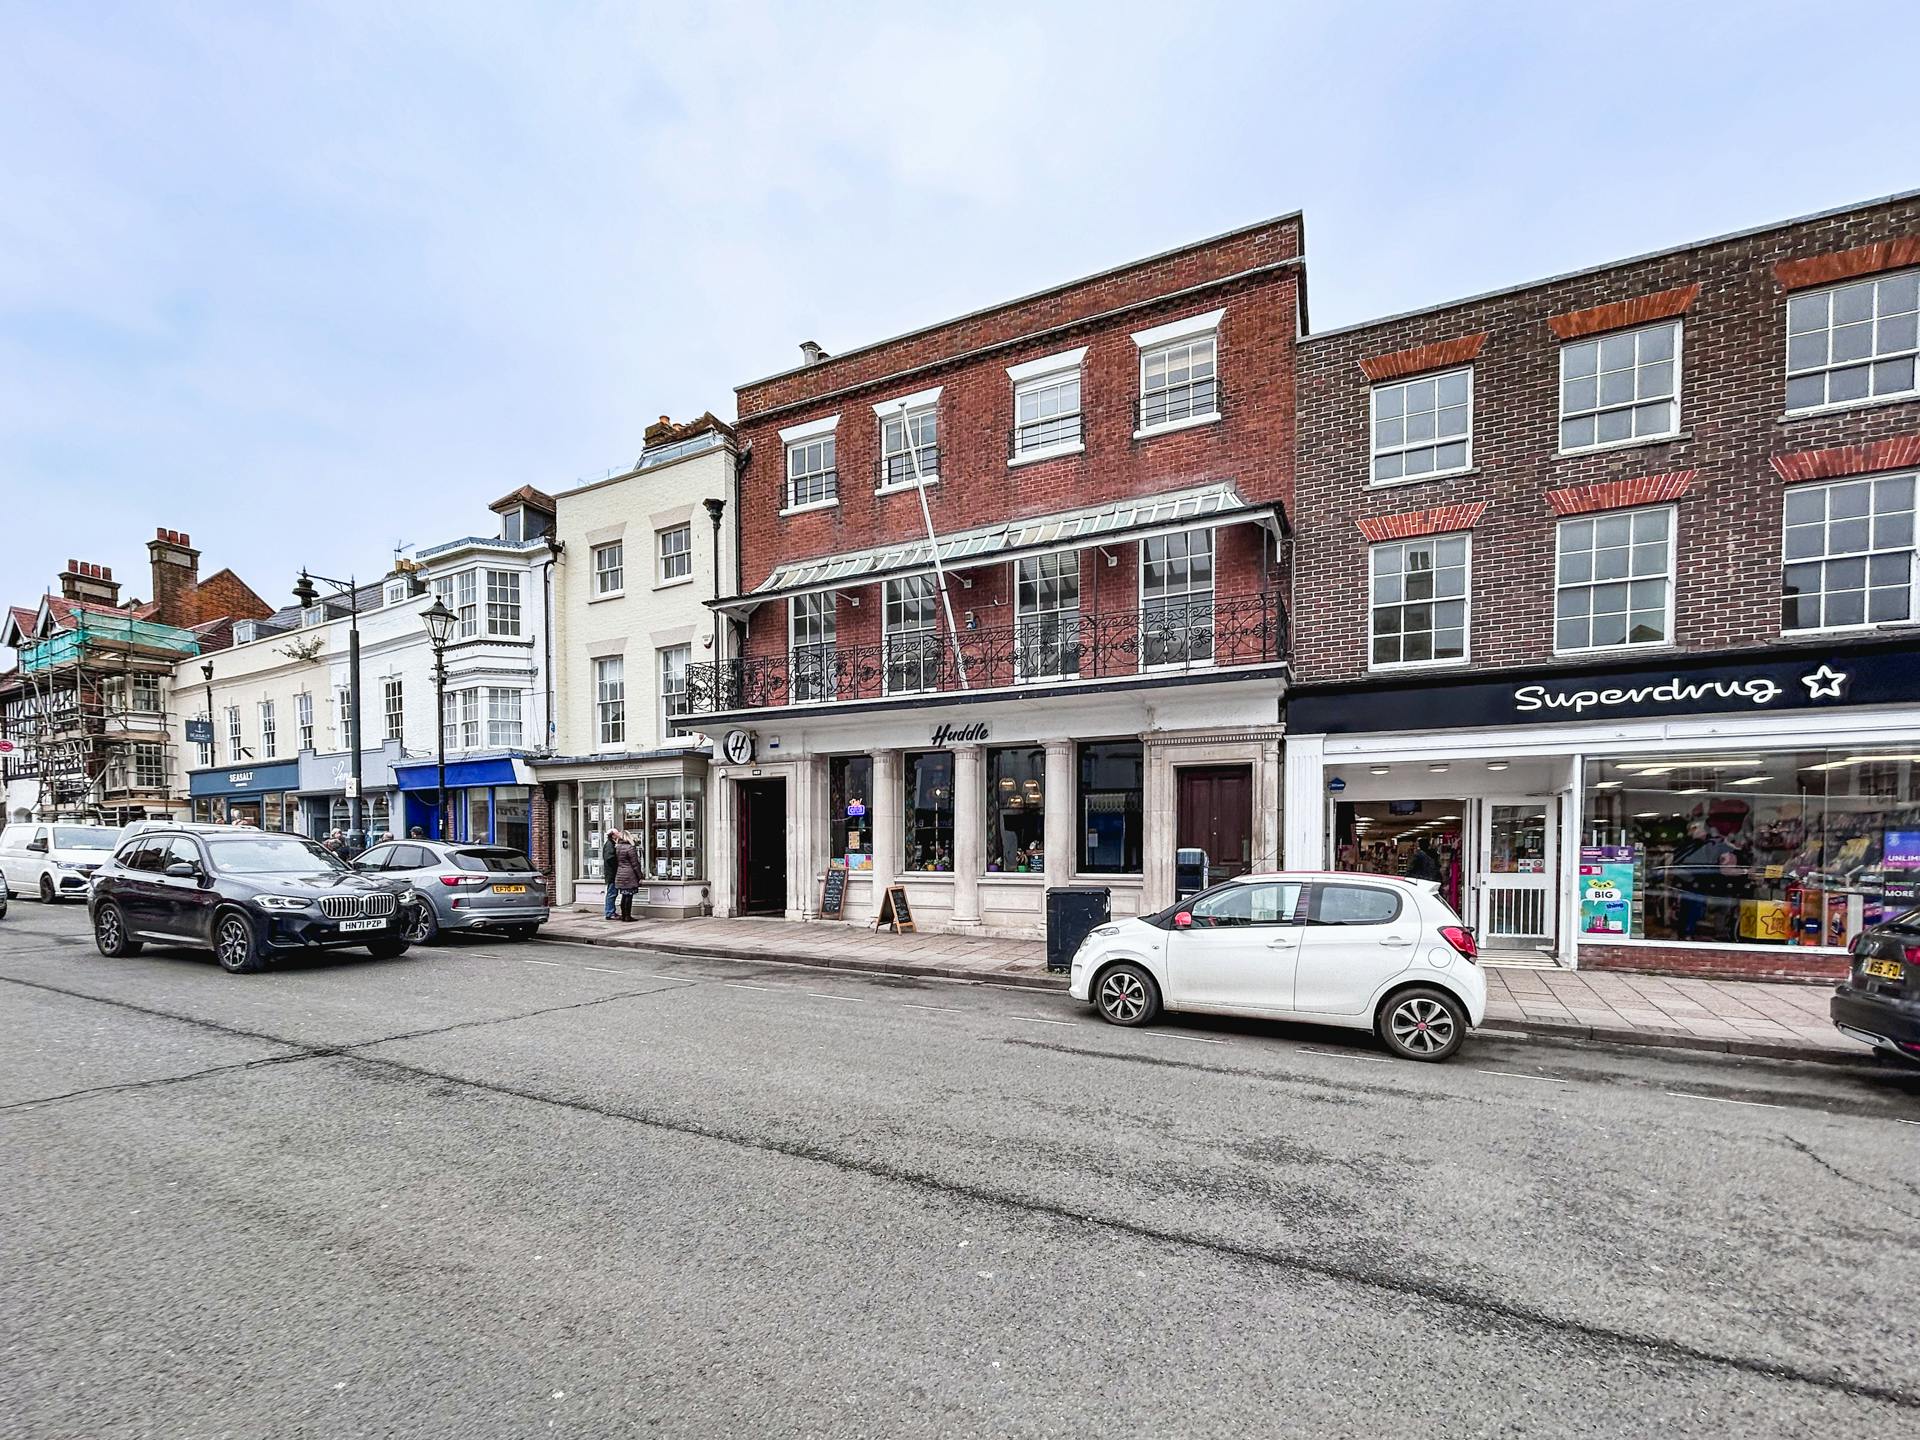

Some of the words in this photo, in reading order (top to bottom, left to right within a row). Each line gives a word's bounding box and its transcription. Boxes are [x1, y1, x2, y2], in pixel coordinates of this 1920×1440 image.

[1514, 678, 1782, 713] Superdrug
[931, 722, 989, 749] Huddle
[731, 735, 747, 761] H
[229, 772, 254, 783] SEASALT
[1594, 891, 1613, 899] BIG
[345, 921, 365, 930] HN71
[366, 919, 382, 928] PZP
